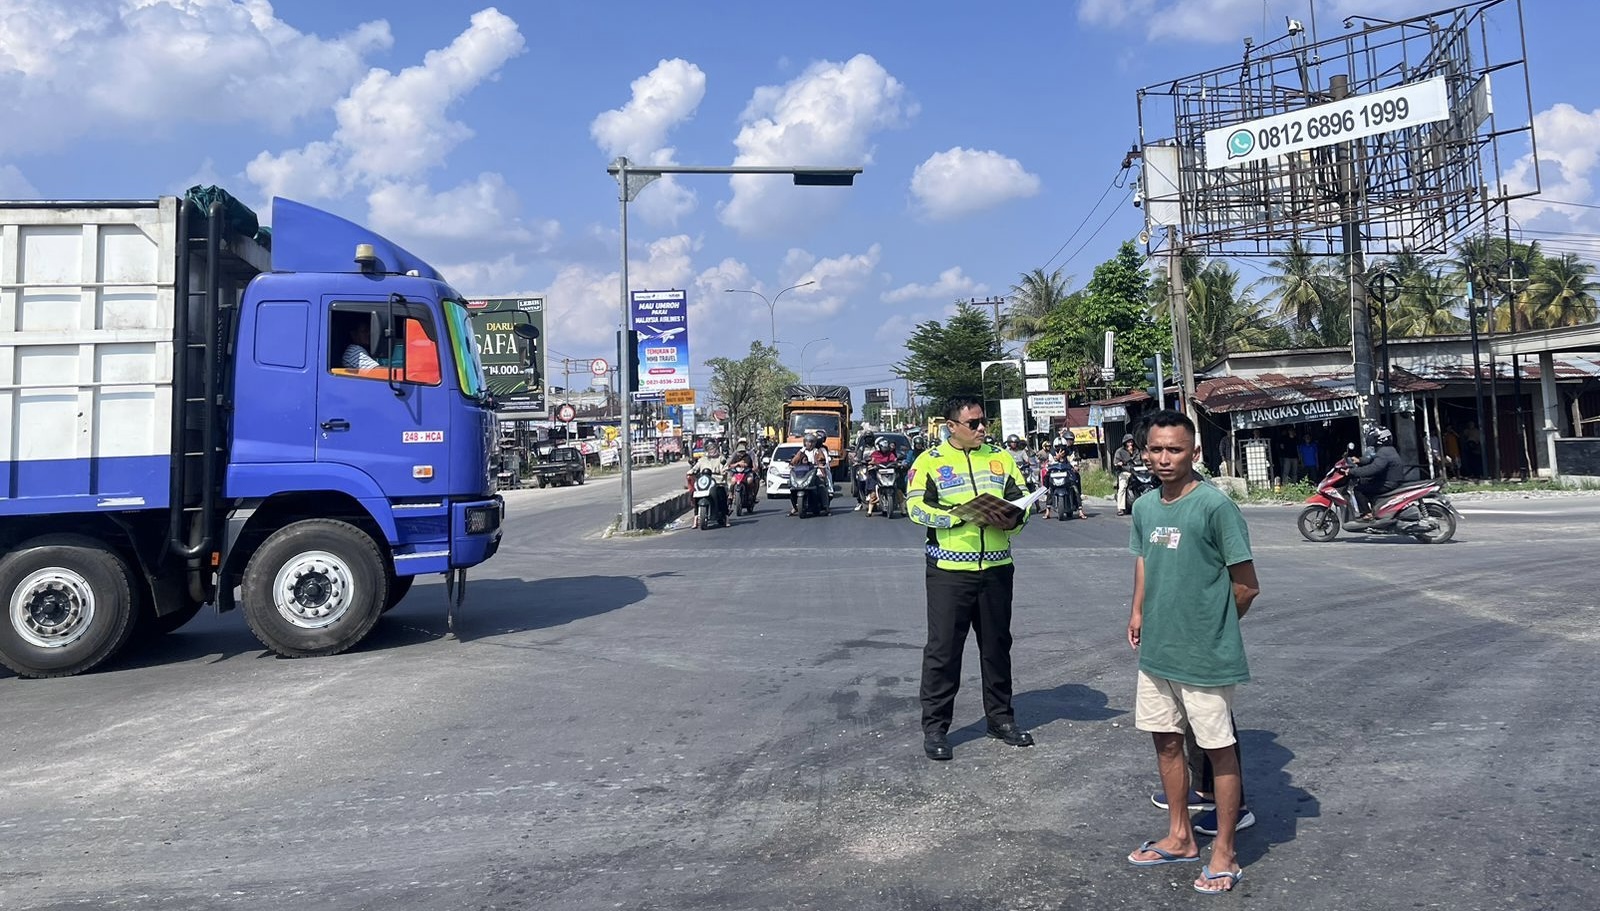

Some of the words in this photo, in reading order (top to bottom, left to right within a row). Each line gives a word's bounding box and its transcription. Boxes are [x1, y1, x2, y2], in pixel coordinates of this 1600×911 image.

[1258, 121, 1303, 150] 0812
[1307, 109, 1355, 140] 6896
[1359, 97, 1409, 128] 1999
[655, 302, 680, 310] UMROH
[486, 322, 516, 331] DJARU
[1251, 406, 1299, 422] PANGKAS
[1301, 400, 1331, 415] GAUL
[425, 432, 442, 441] HCA
[910, 504, 951, 528] POLISI
